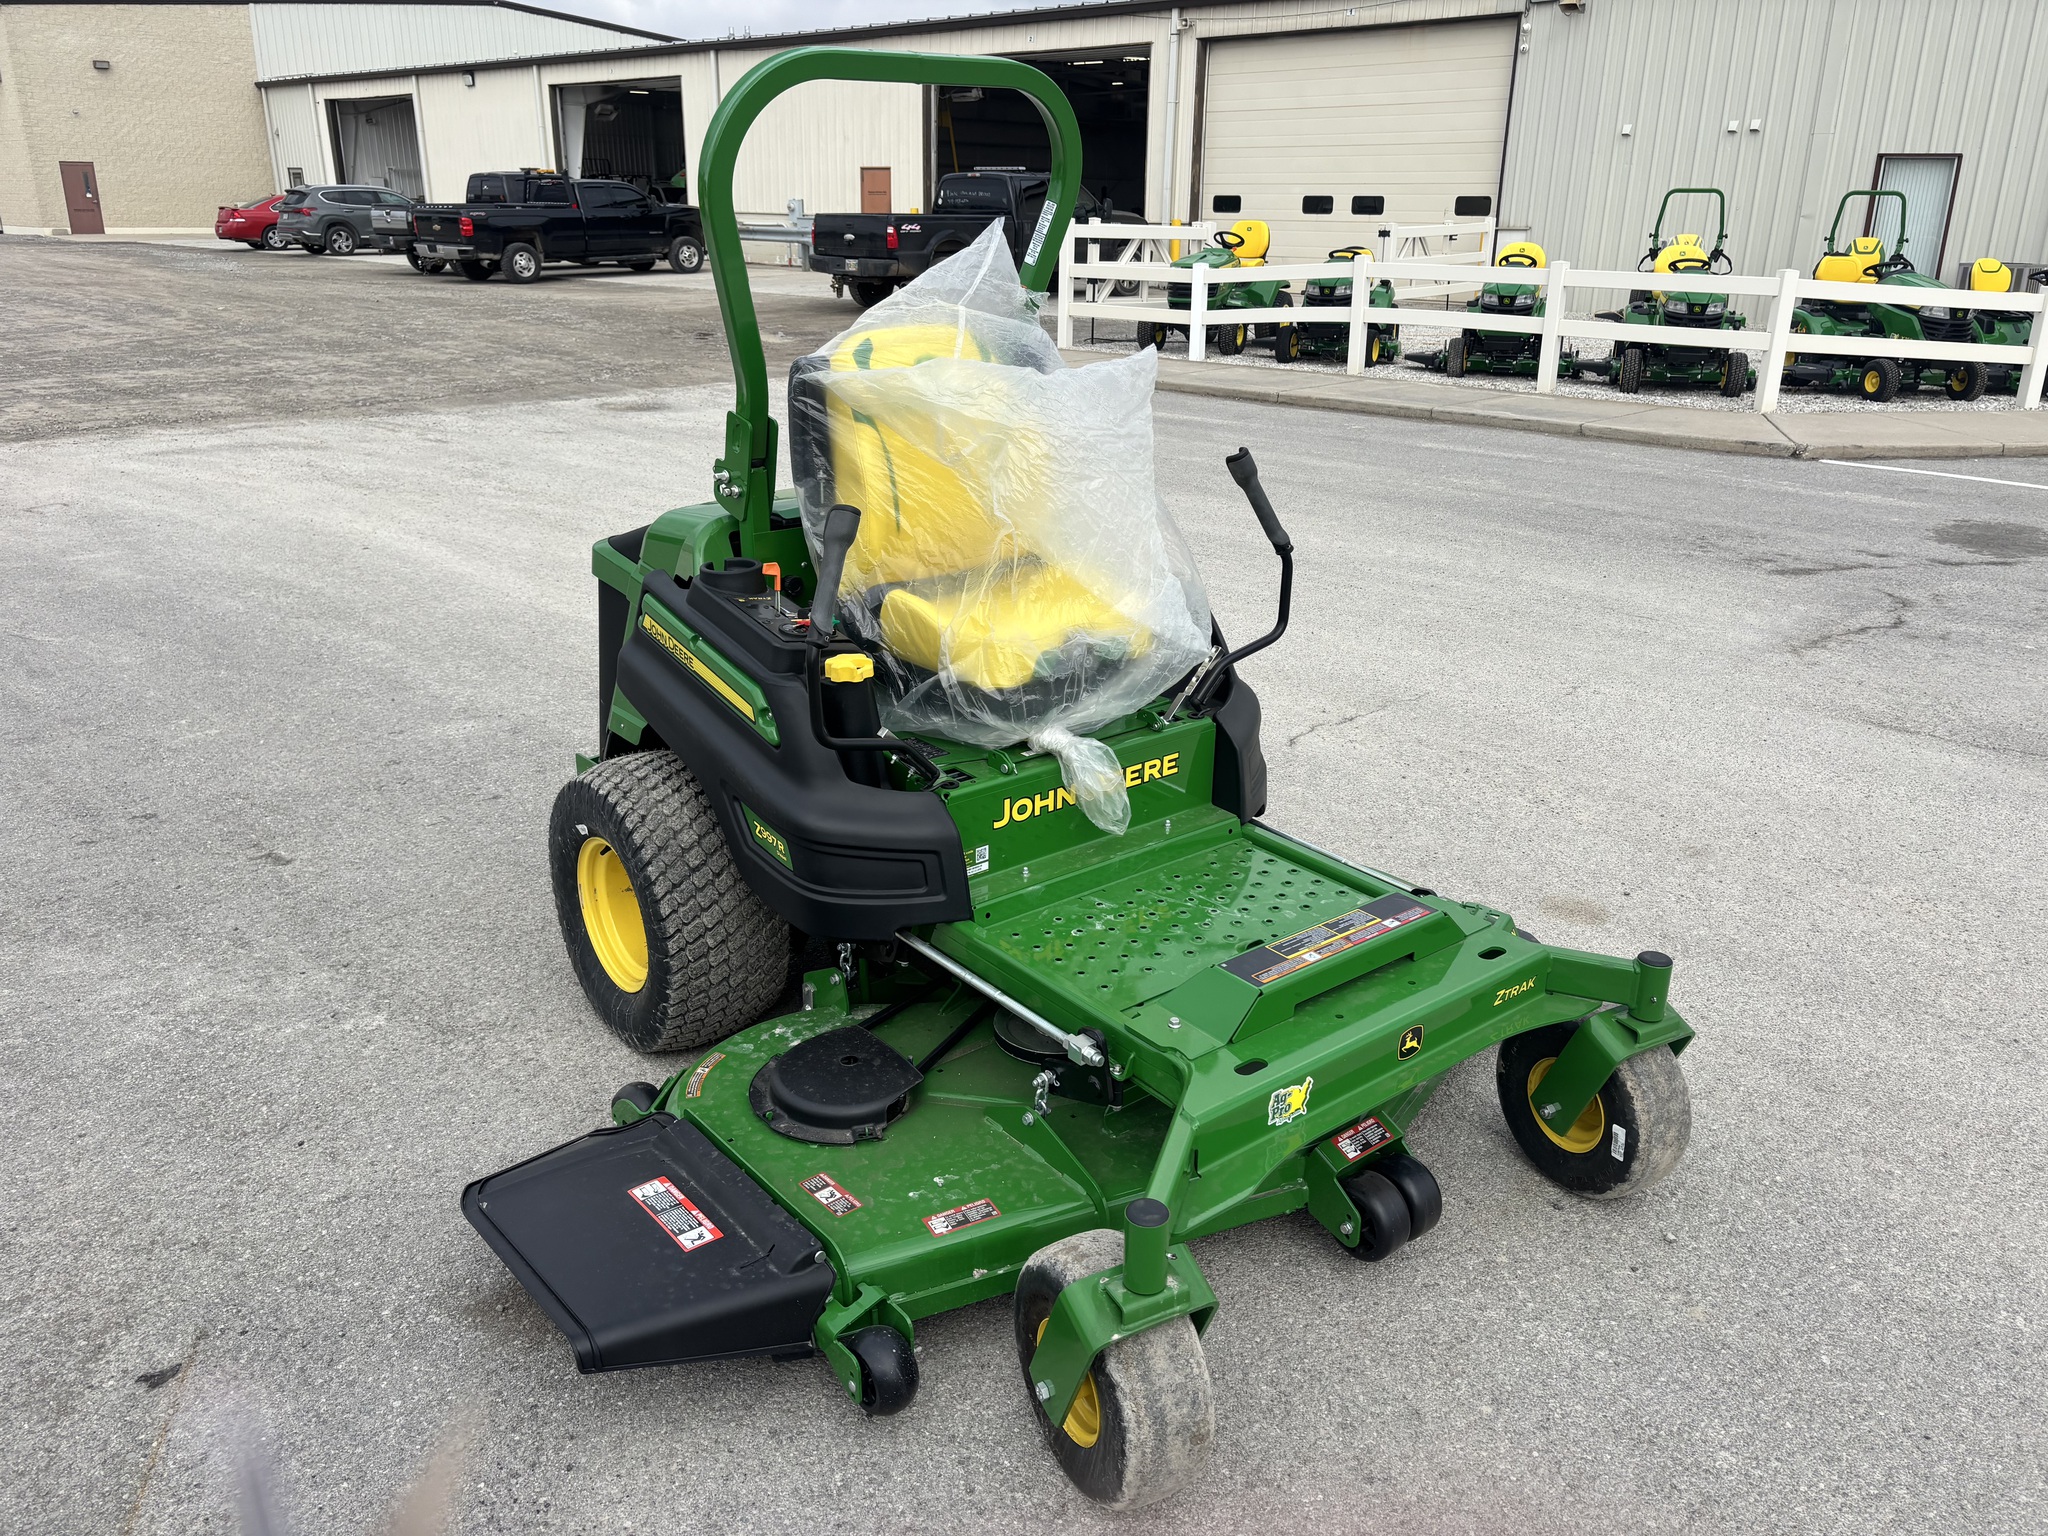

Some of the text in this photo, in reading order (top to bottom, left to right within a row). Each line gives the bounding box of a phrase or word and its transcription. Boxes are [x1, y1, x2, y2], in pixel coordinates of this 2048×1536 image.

[646, 619, 695, 670] JOHN DEERE
[993, 783, 1077, 830] JOHN
[1493, 976, 1537, 1007] ZTRAK
